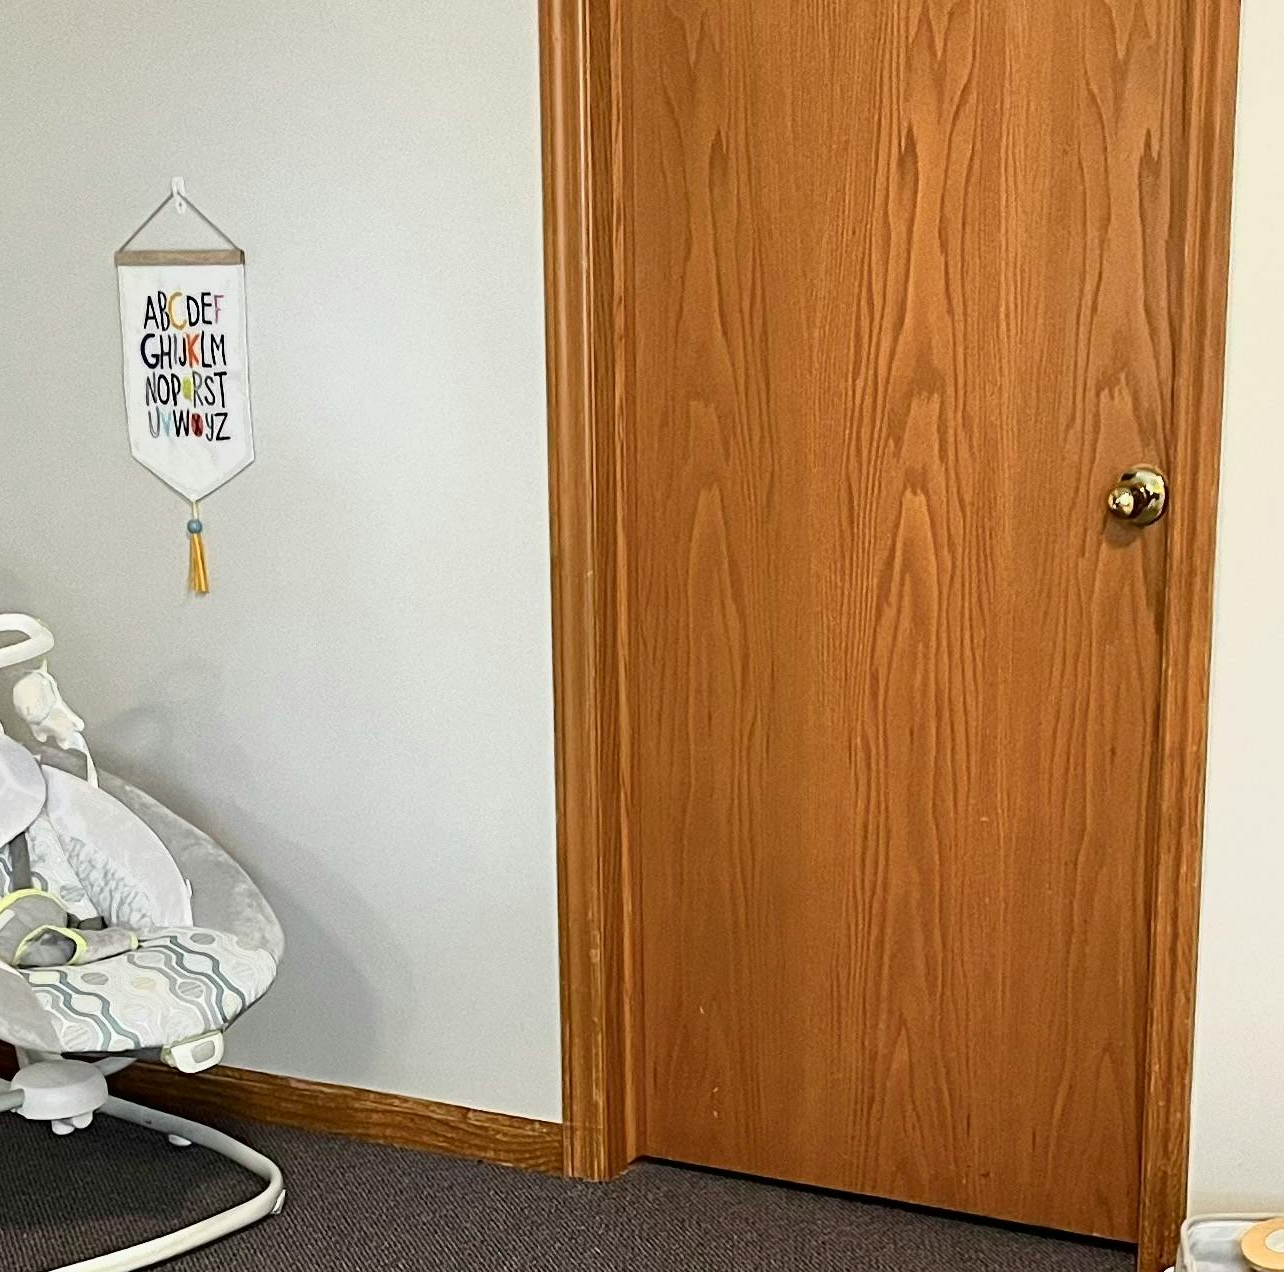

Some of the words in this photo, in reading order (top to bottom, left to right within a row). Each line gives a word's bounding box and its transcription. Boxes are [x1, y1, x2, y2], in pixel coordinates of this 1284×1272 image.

[144, 291, 224, 331] ABCDEF
[140, 331, 227, 369] GHIJKLM
[148, 406, 231, 441] UVWXYZ
